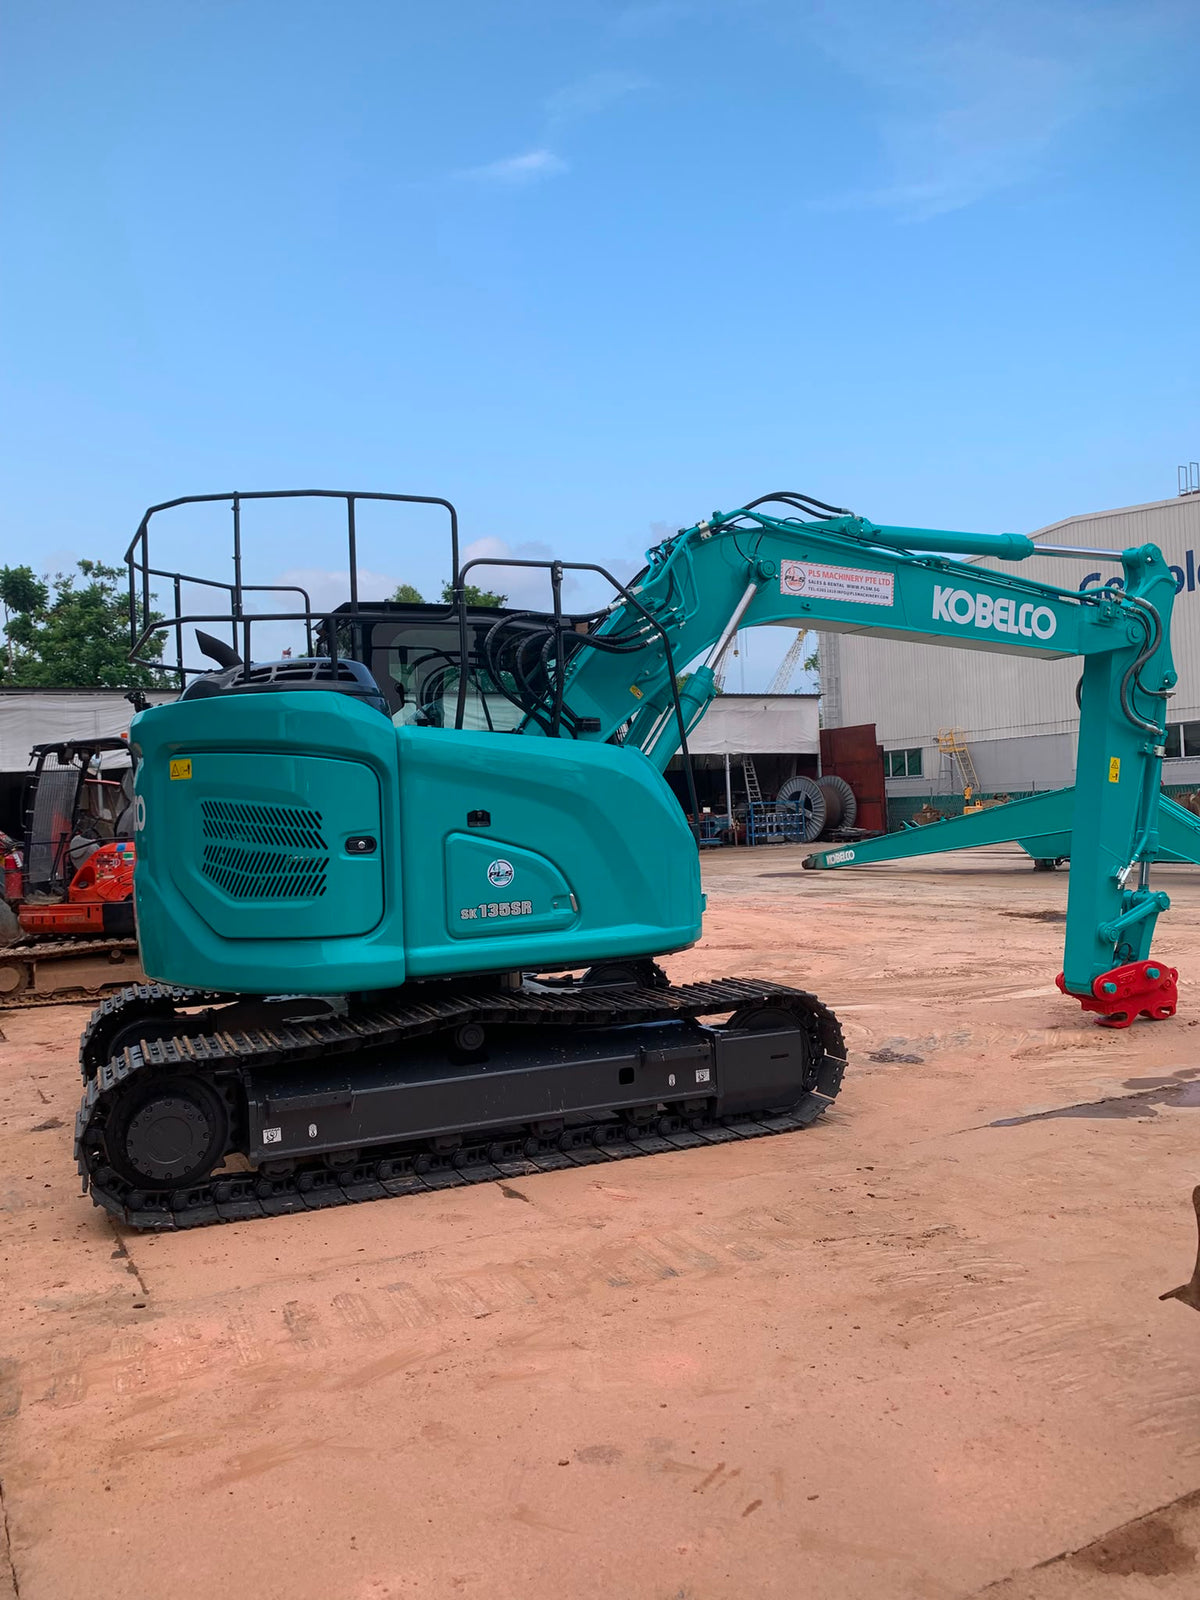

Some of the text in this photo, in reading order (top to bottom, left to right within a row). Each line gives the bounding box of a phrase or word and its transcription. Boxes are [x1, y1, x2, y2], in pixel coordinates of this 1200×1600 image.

[784, 574, 806, 583] PLS
[808, 569, 891, 586] PLS MACHINERY PTE LTD
[932, 585, 1057, 640] KOBELCO
[826, 849, 855, 866] KOBELCO
[489, 870, 513, 878] PLS
